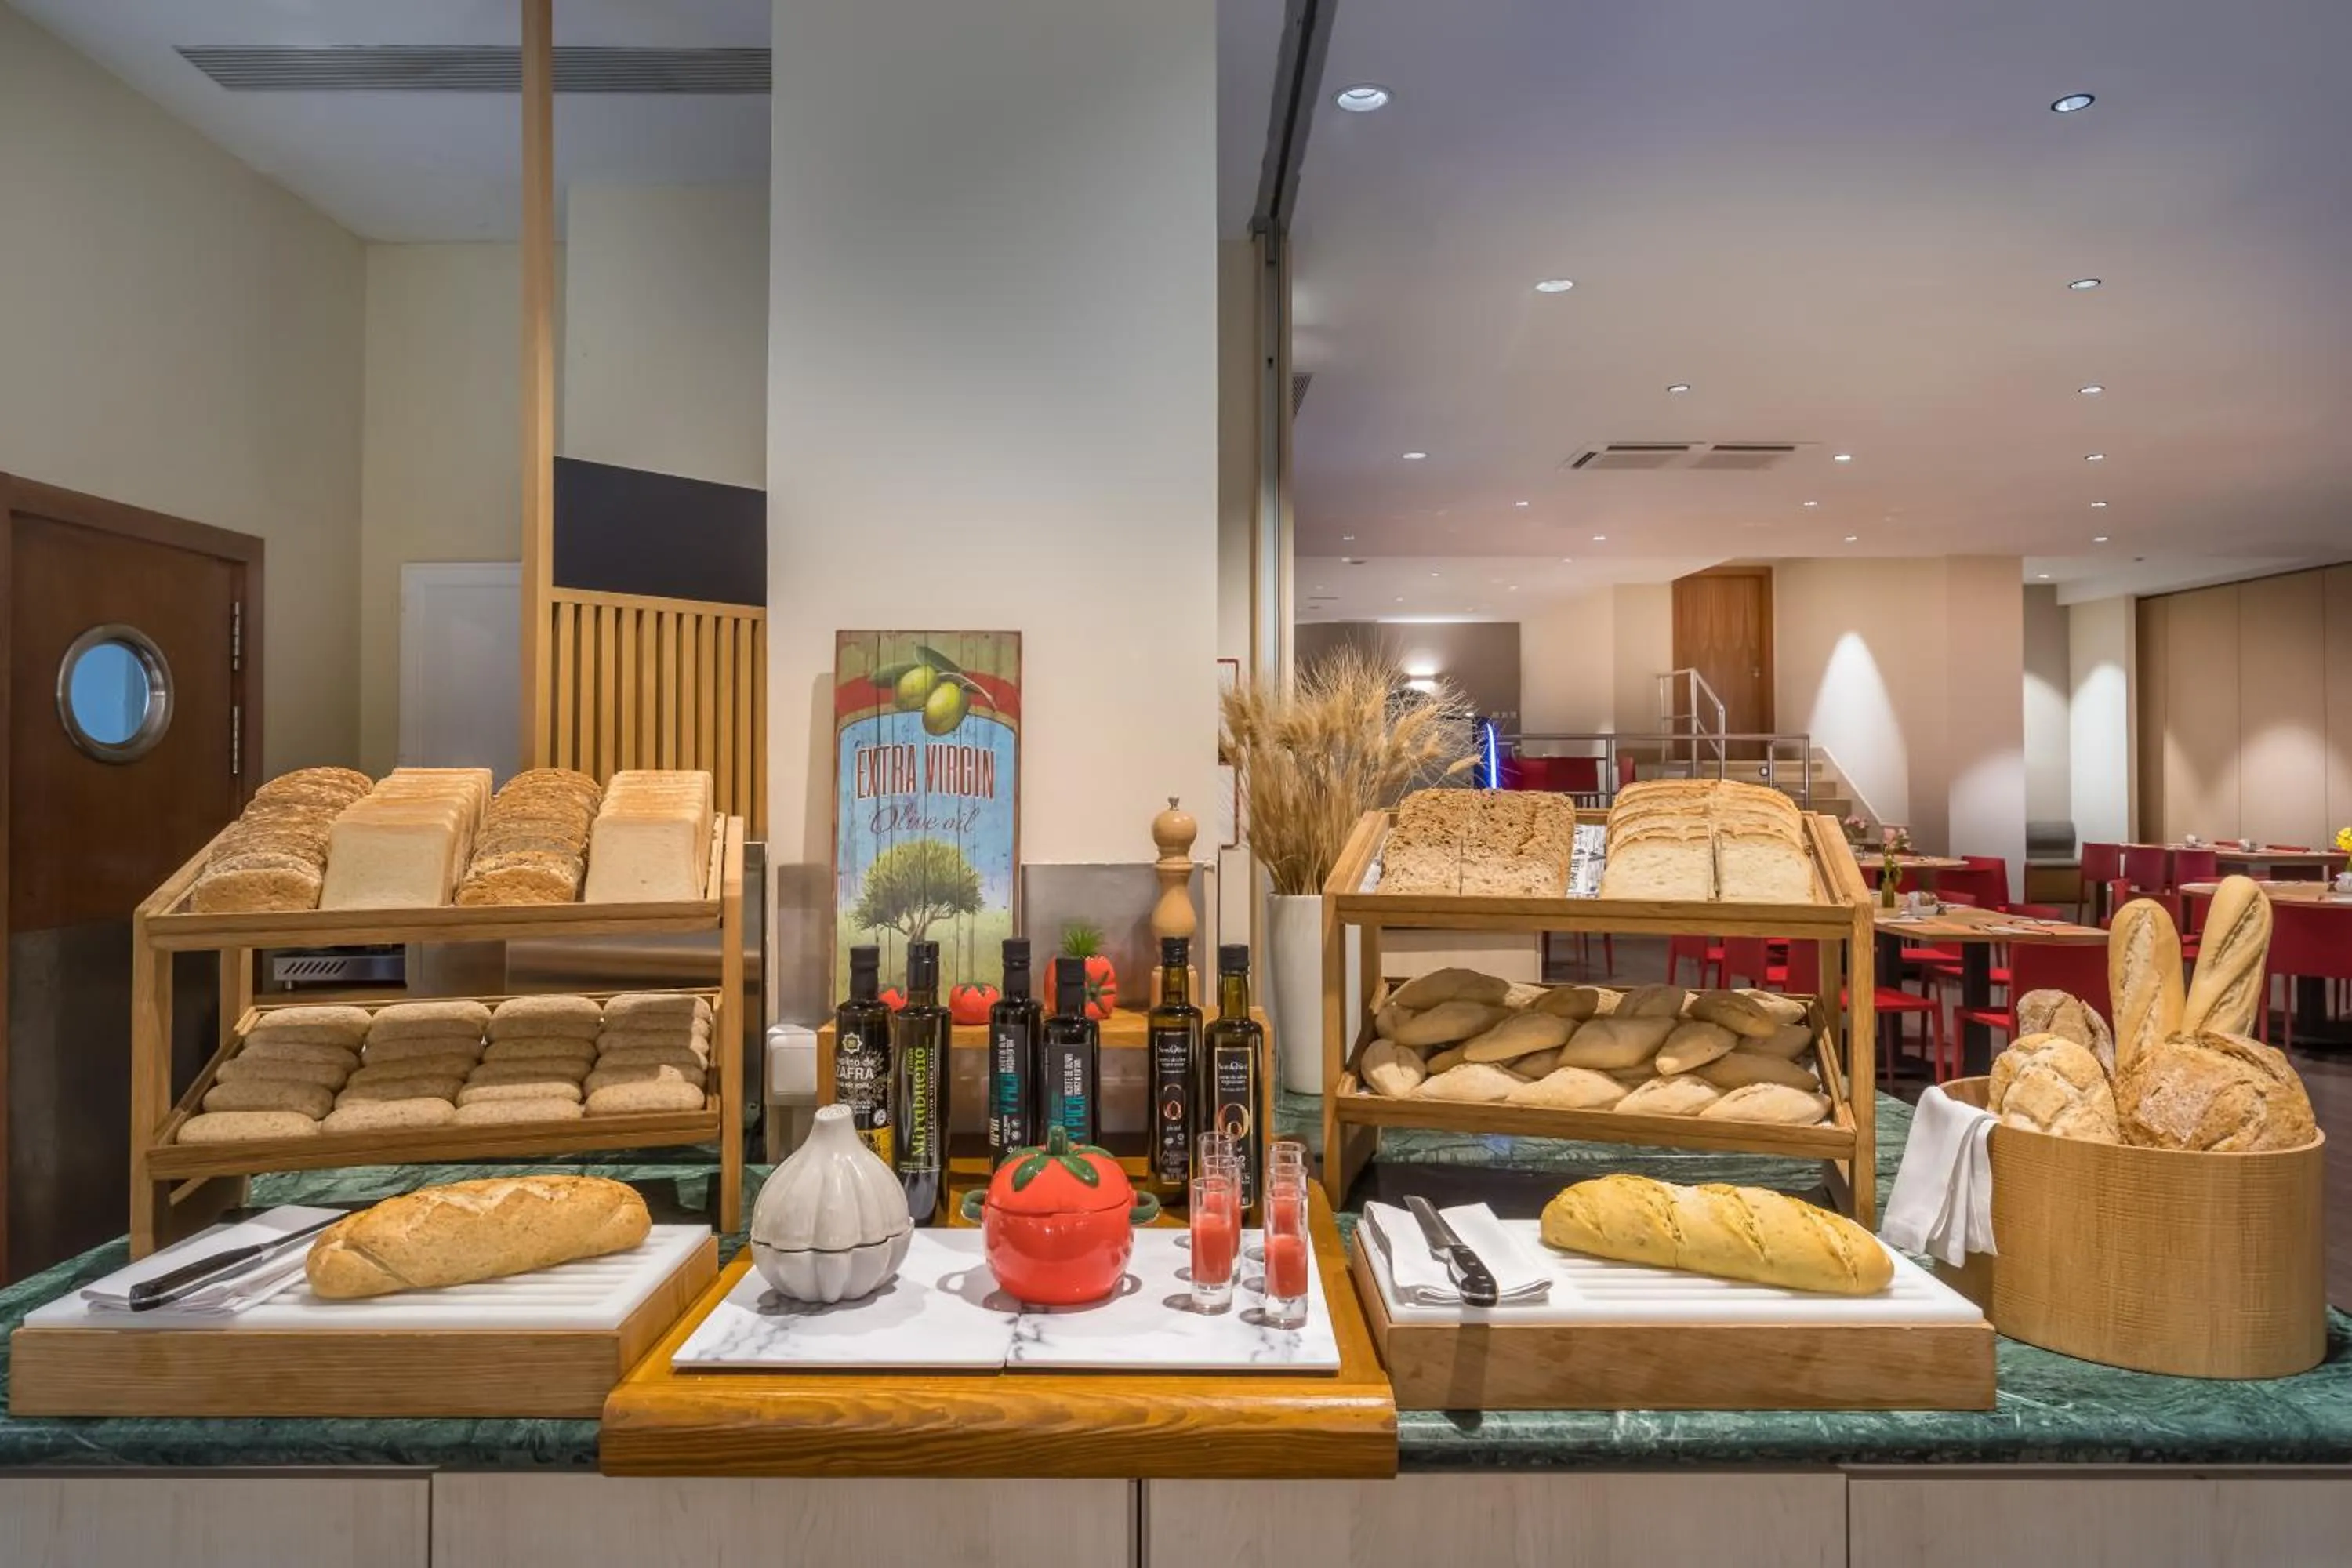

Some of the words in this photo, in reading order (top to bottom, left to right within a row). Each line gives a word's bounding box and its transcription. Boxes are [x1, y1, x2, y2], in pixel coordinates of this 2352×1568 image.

[857, 744, 916, 799] EXTRA
[924, 744, 994, 800] VIRGIN
[869, 801, 937, 835] Olive
[942, 804, 980, 833] oil
[913, 1047, 926, 1156] Mirabueno
